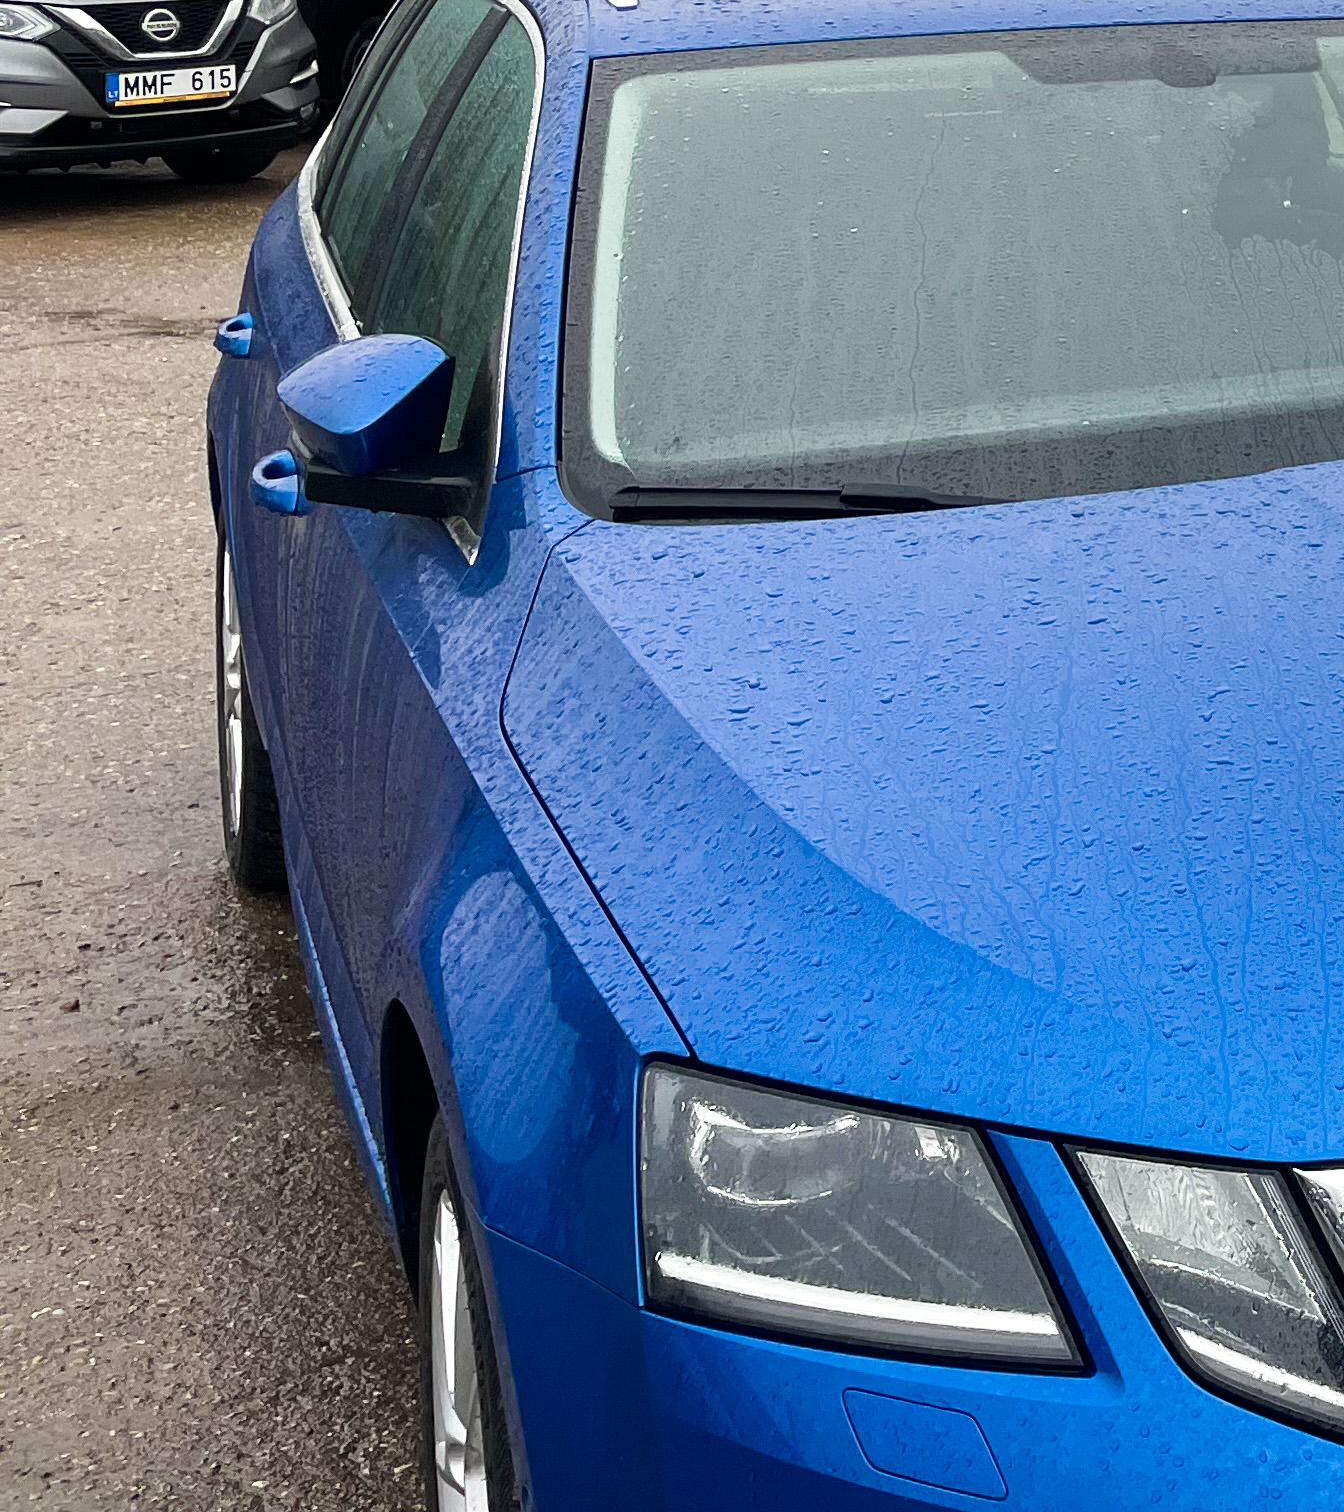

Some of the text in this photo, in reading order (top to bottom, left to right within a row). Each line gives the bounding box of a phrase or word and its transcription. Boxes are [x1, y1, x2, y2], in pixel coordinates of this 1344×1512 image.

[108, 68, 232, 99] LT MMF 615
